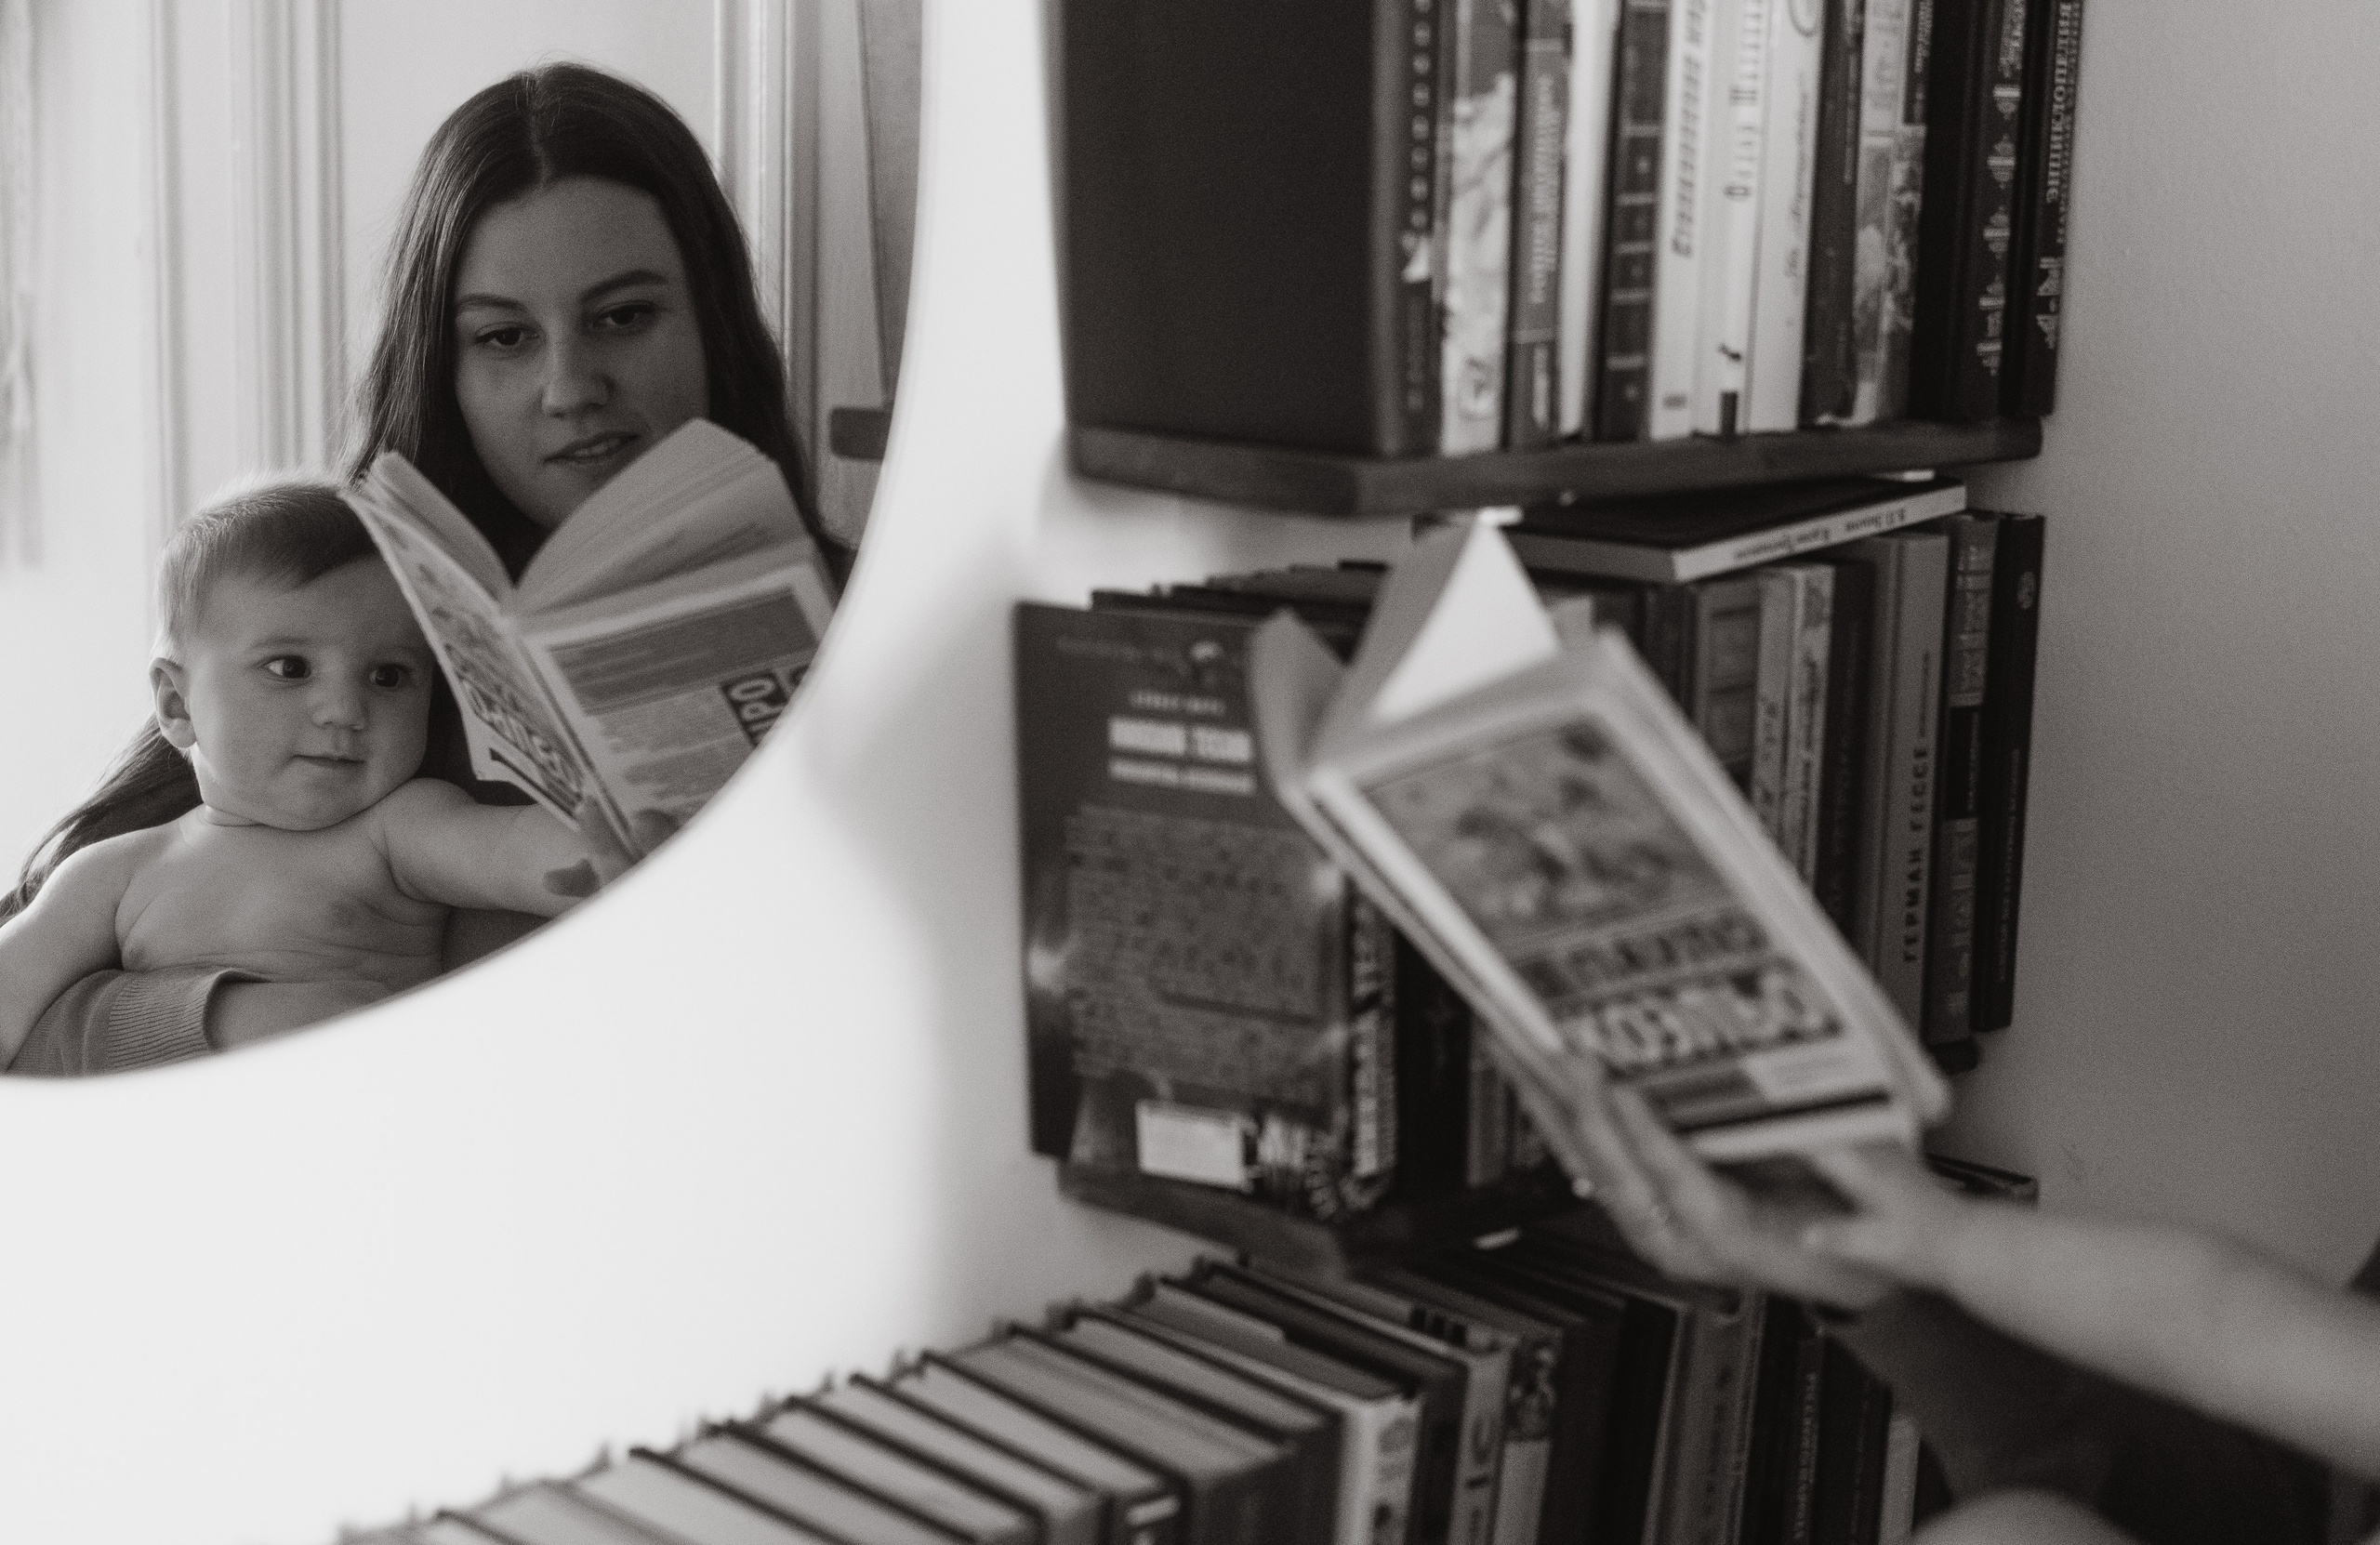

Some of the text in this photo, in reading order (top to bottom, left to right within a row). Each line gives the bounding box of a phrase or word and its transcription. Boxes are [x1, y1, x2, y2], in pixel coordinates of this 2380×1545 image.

[2047, 2, 2072, 204] ЭНЦИКЛОПЕДИЯ
[1910, 747, 1928, 832] ГЕССЕ
[1905, 848, 1923, 963] ГЕРМАН
